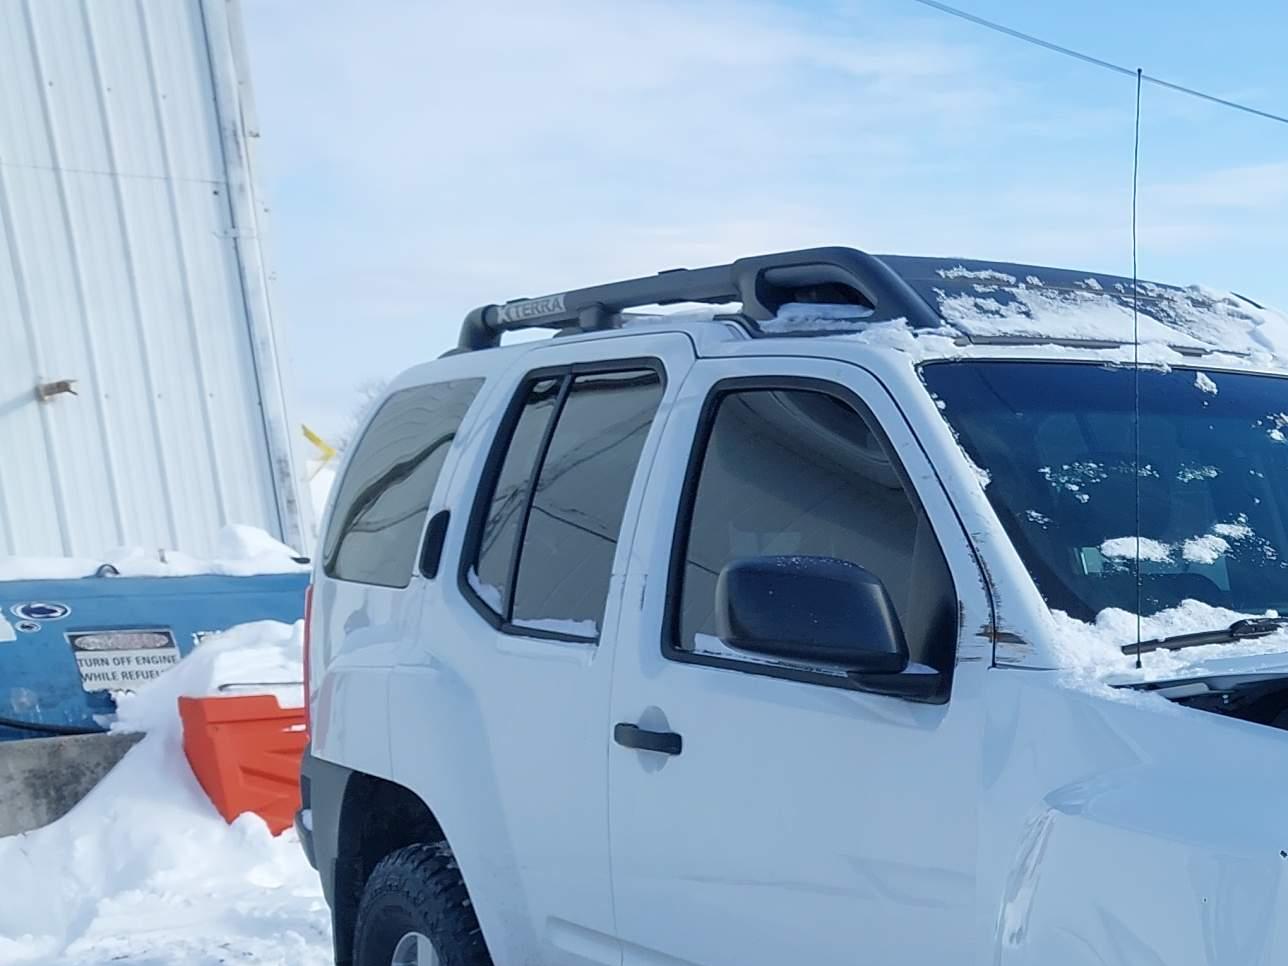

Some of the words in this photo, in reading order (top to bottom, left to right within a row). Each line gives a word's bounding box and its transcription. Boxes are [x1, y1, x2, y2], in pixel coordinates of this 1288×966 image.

[497, 296, 565, 324] XTERRA
[78, 658, 110, 668] TURN
[113, 656, 132, 666] OFF
[135, 655, 177, 665] ENGINE
[81, 671, 120, 682] WHILE
[121, 670, 164, 681] REFUE
